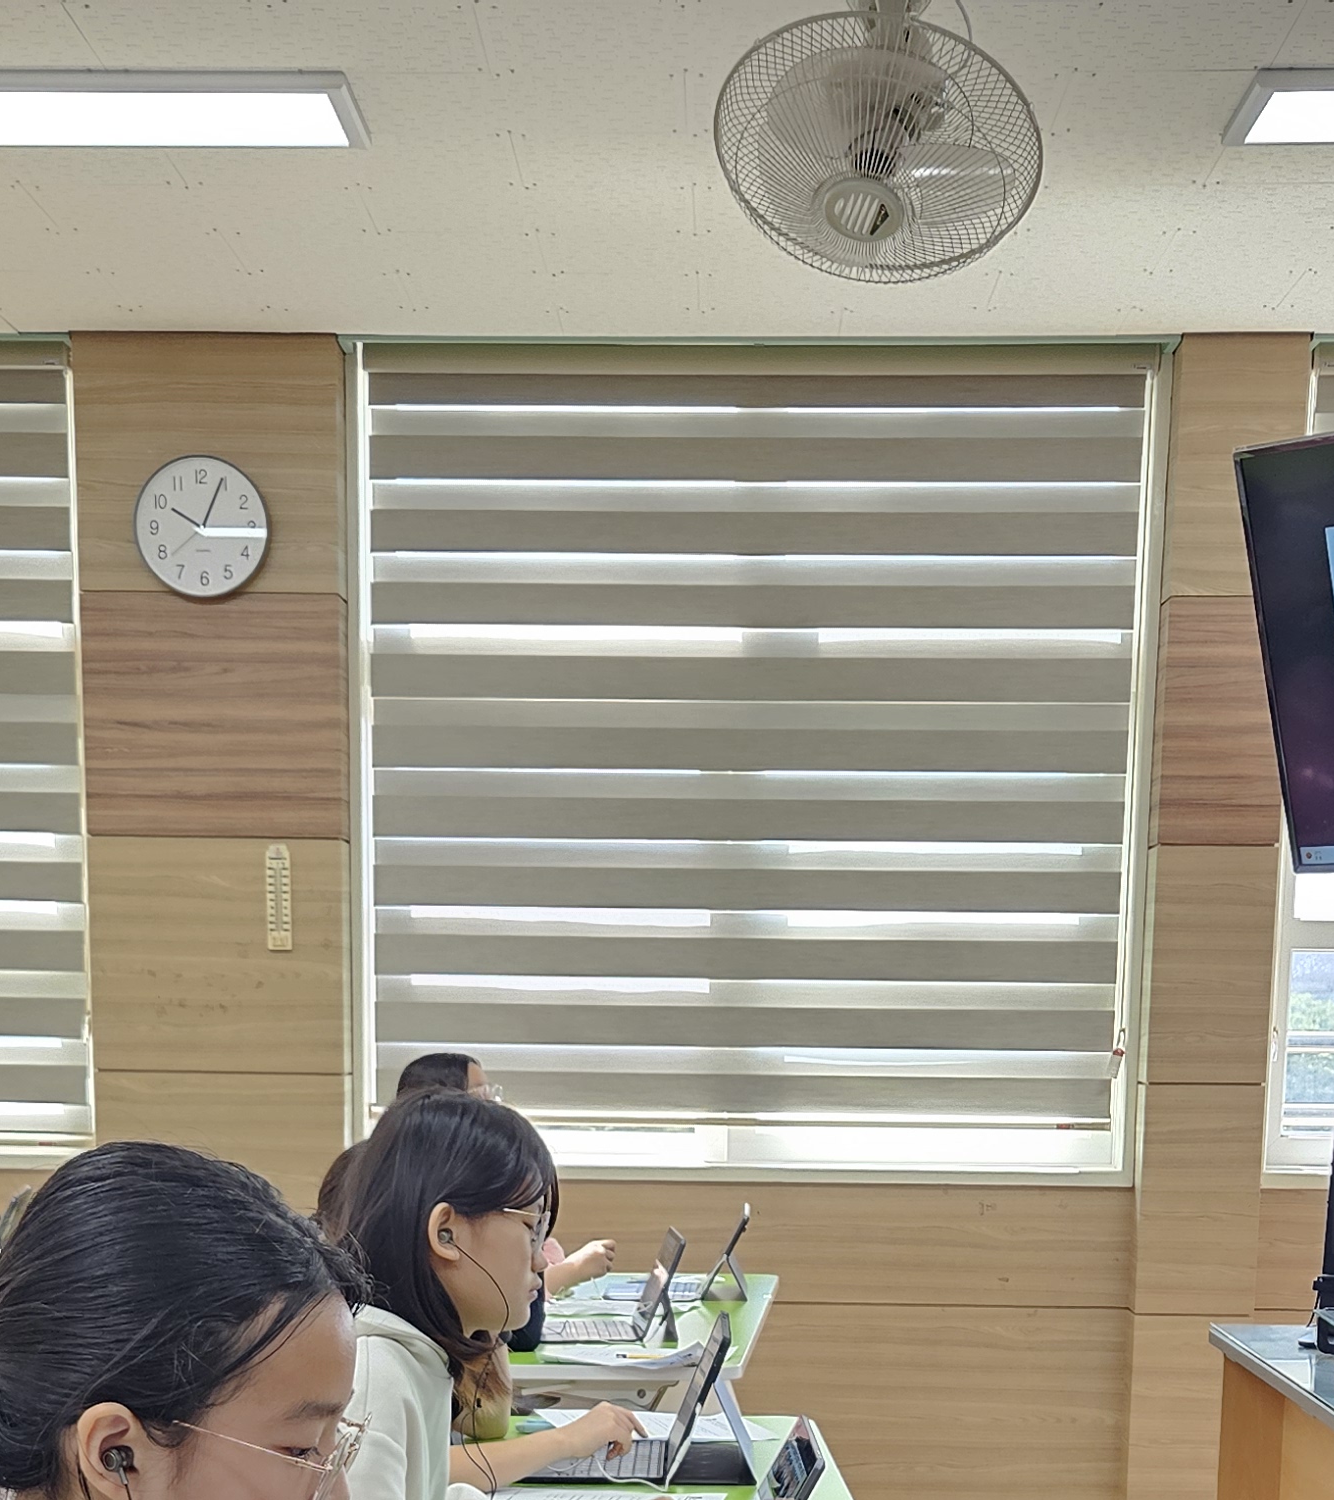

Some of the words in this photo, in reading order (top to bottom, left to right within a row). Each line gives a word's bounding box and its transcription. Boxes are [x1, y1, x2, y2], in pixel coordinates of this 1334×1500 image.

[173, 476, 183, 491] 11
[194, 469, 208, 485] 12
[154, 494, 167, 509] 10
[239, 494, 249, 510] 2
[149, 520, 159, 535] 9
[158, 544, 167, 560] 8
[240, 545, 250, 560] 4
[176, 564, 185, 579] 7
[200, 571, 210, 586] 6
[223, 564, 234, 580] 5
